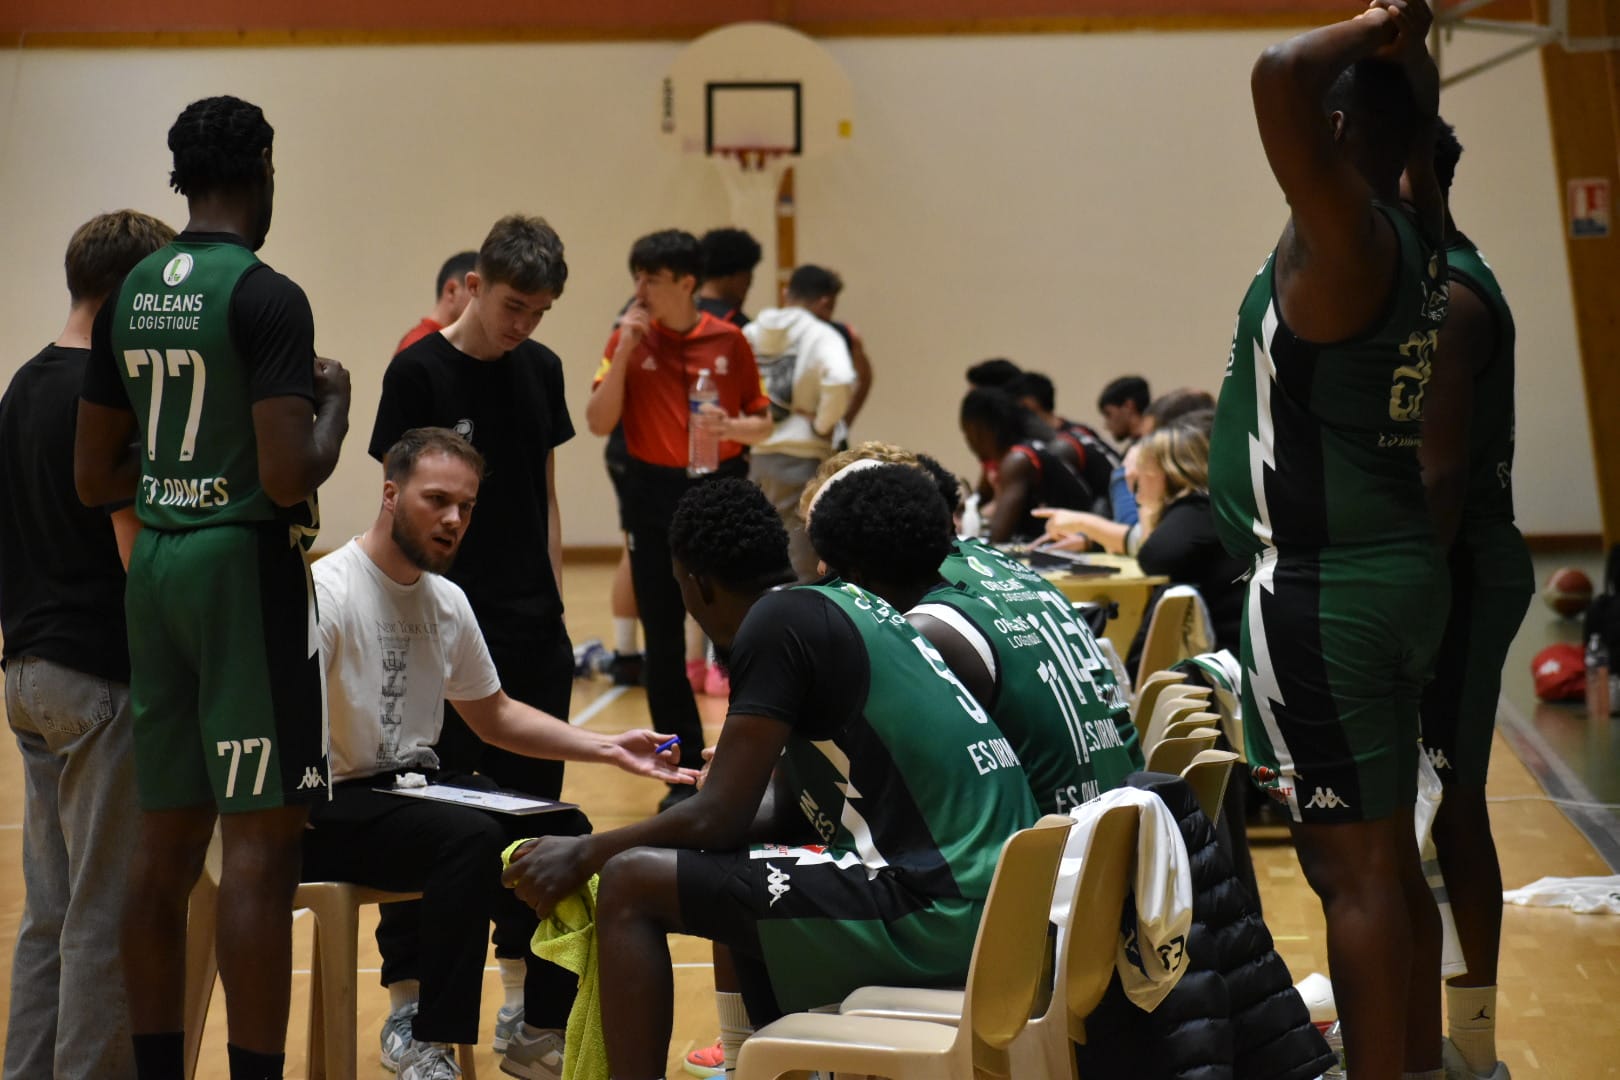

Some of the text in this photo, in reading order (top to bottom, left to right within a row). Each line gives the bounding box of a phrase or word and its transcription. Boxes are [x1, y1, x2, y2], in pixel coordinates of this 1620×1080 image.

[132, 293, 204, 312] ORLEANS
[129, 315, 201, 331] LOGISTIQUE
[124, 348, 206, 462] 77
[159, 476, 229, 508] ORMES
[217, 737, 271, 798] 77
[966, 740, 998, 776] ES
